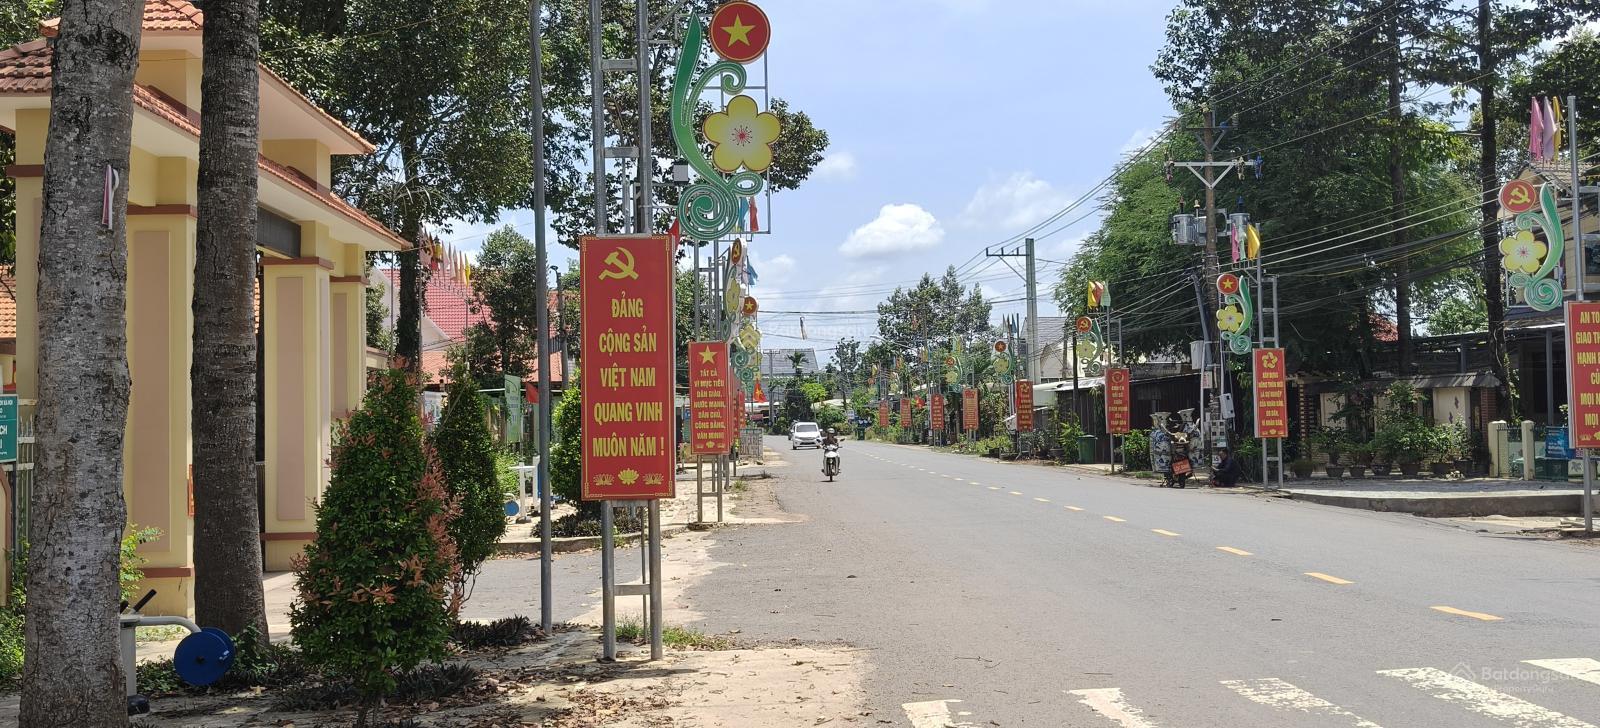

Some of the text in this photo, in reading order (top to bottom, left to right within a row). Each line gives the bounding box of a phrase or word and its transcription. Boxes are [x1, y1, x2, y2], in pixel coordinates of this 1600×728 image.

[611, 291, 644, 318] ĐẢNG
[1580, 311, 1590, 324] AN
[598, 325, 657, 357] CỘNG SẢN
[1576, 331, 1592, 345] GIAO
[1577, 352, 1598, 367] HẠNH
[600, 362, 656, 391] VIỆT NAM
[1581, 393, 1595, 408] MỌI
[593, 401, 663, 426] QUANG VINH
[1585, 413, 1599, 428] MỌI
[592, 431, 665, 457] MUÔN NĂM !
